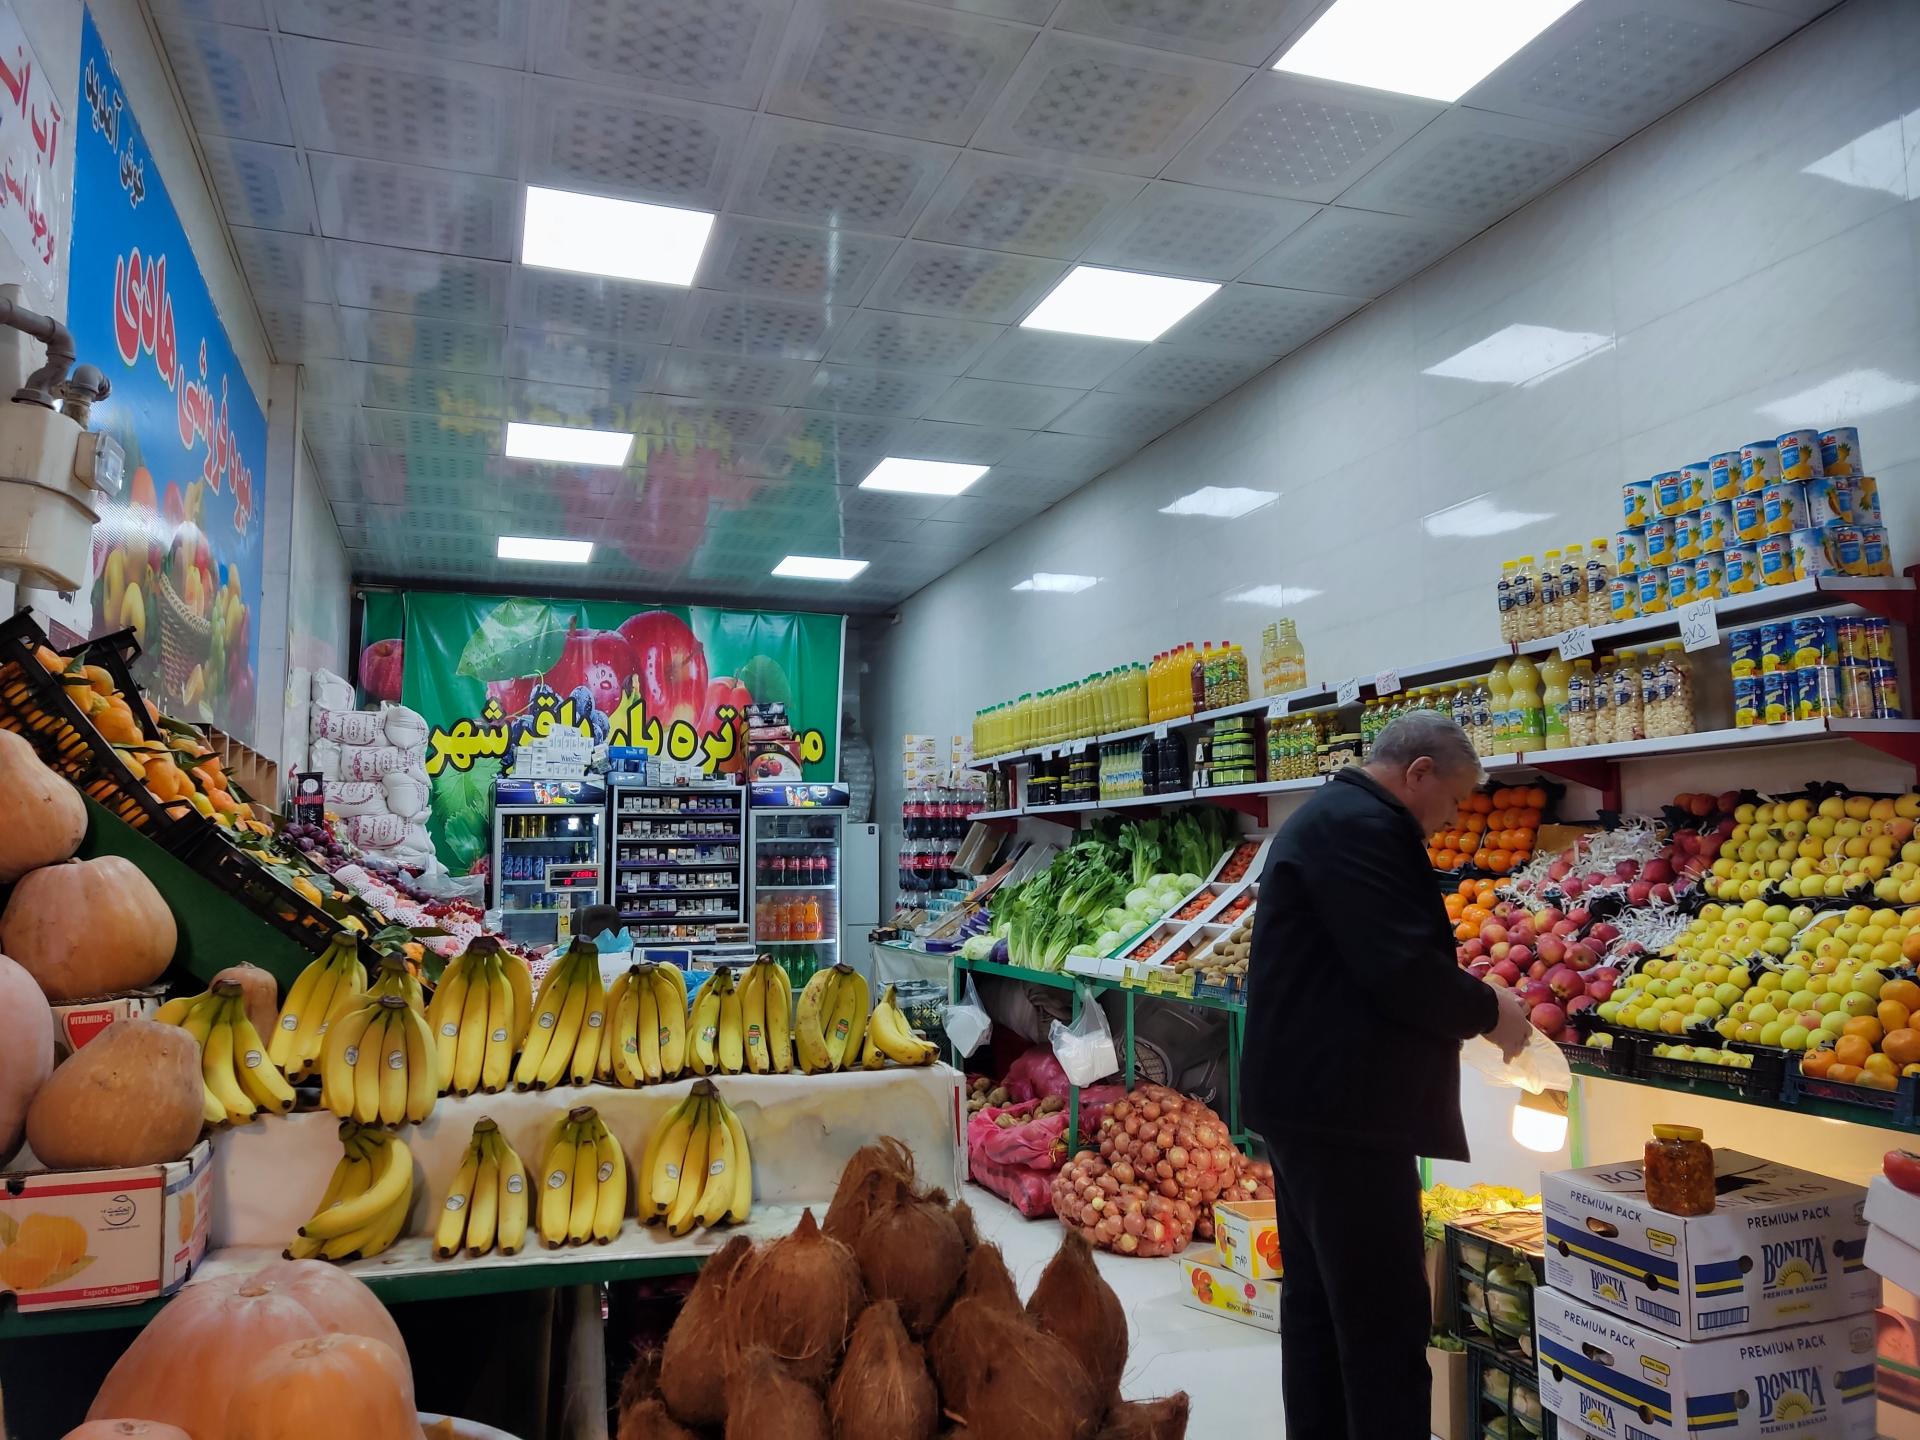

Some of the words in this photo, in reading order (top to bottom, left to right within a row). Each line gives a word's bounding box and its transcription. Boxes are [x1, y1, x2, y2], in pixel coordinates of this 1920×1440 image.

[177, 336, 229, 497] فروشی
[1780, 436, 1799, 448] Dole
[1711, 457, 1729, 469] Dole
[1659, 476, 1679, 487] Dole
[1737, 498, 1756, 510] Dole
[1837, 531, 1859, 543] Dole
[1760, 541, 1781, 555] Dole
[425, 697, 511, 776] شهر
[70, 1014, 112, 1025] VITAMIN-C
[1570, 1190, 1613, 1215] PREMIUM
[1616, 1206, 1642, 1223] PACK
[1747, 1212, 1799, 1230] PREMIUM
[1802, 1206, 1831, 1220] PACK
[1761, 1235, 1828, 1285] BONITA
[83, 1287, 109, 1297] Export
[111, 1284, 140, 1295] Quality
[1590, 1268, 1628, 1302] BONITA
[1763, 1289, 1794, 1300] PREMIUM
[1795, 1283, 1828, 1295] BANANAS
[1564, 1310, 1607, 1337] PREMIUM
[1609, 1330, 1636, 1349] PACK
[1740, 1341, 1794, 1360] PREMIUM
[1797, 1334, 1827, 1348] PACK
[1755, 1365, 1827, 1418] BONITA
[1579, 1392, 1616, 1430] BONITA
[1760, 1423, 1795, 1434] PREMIUM
